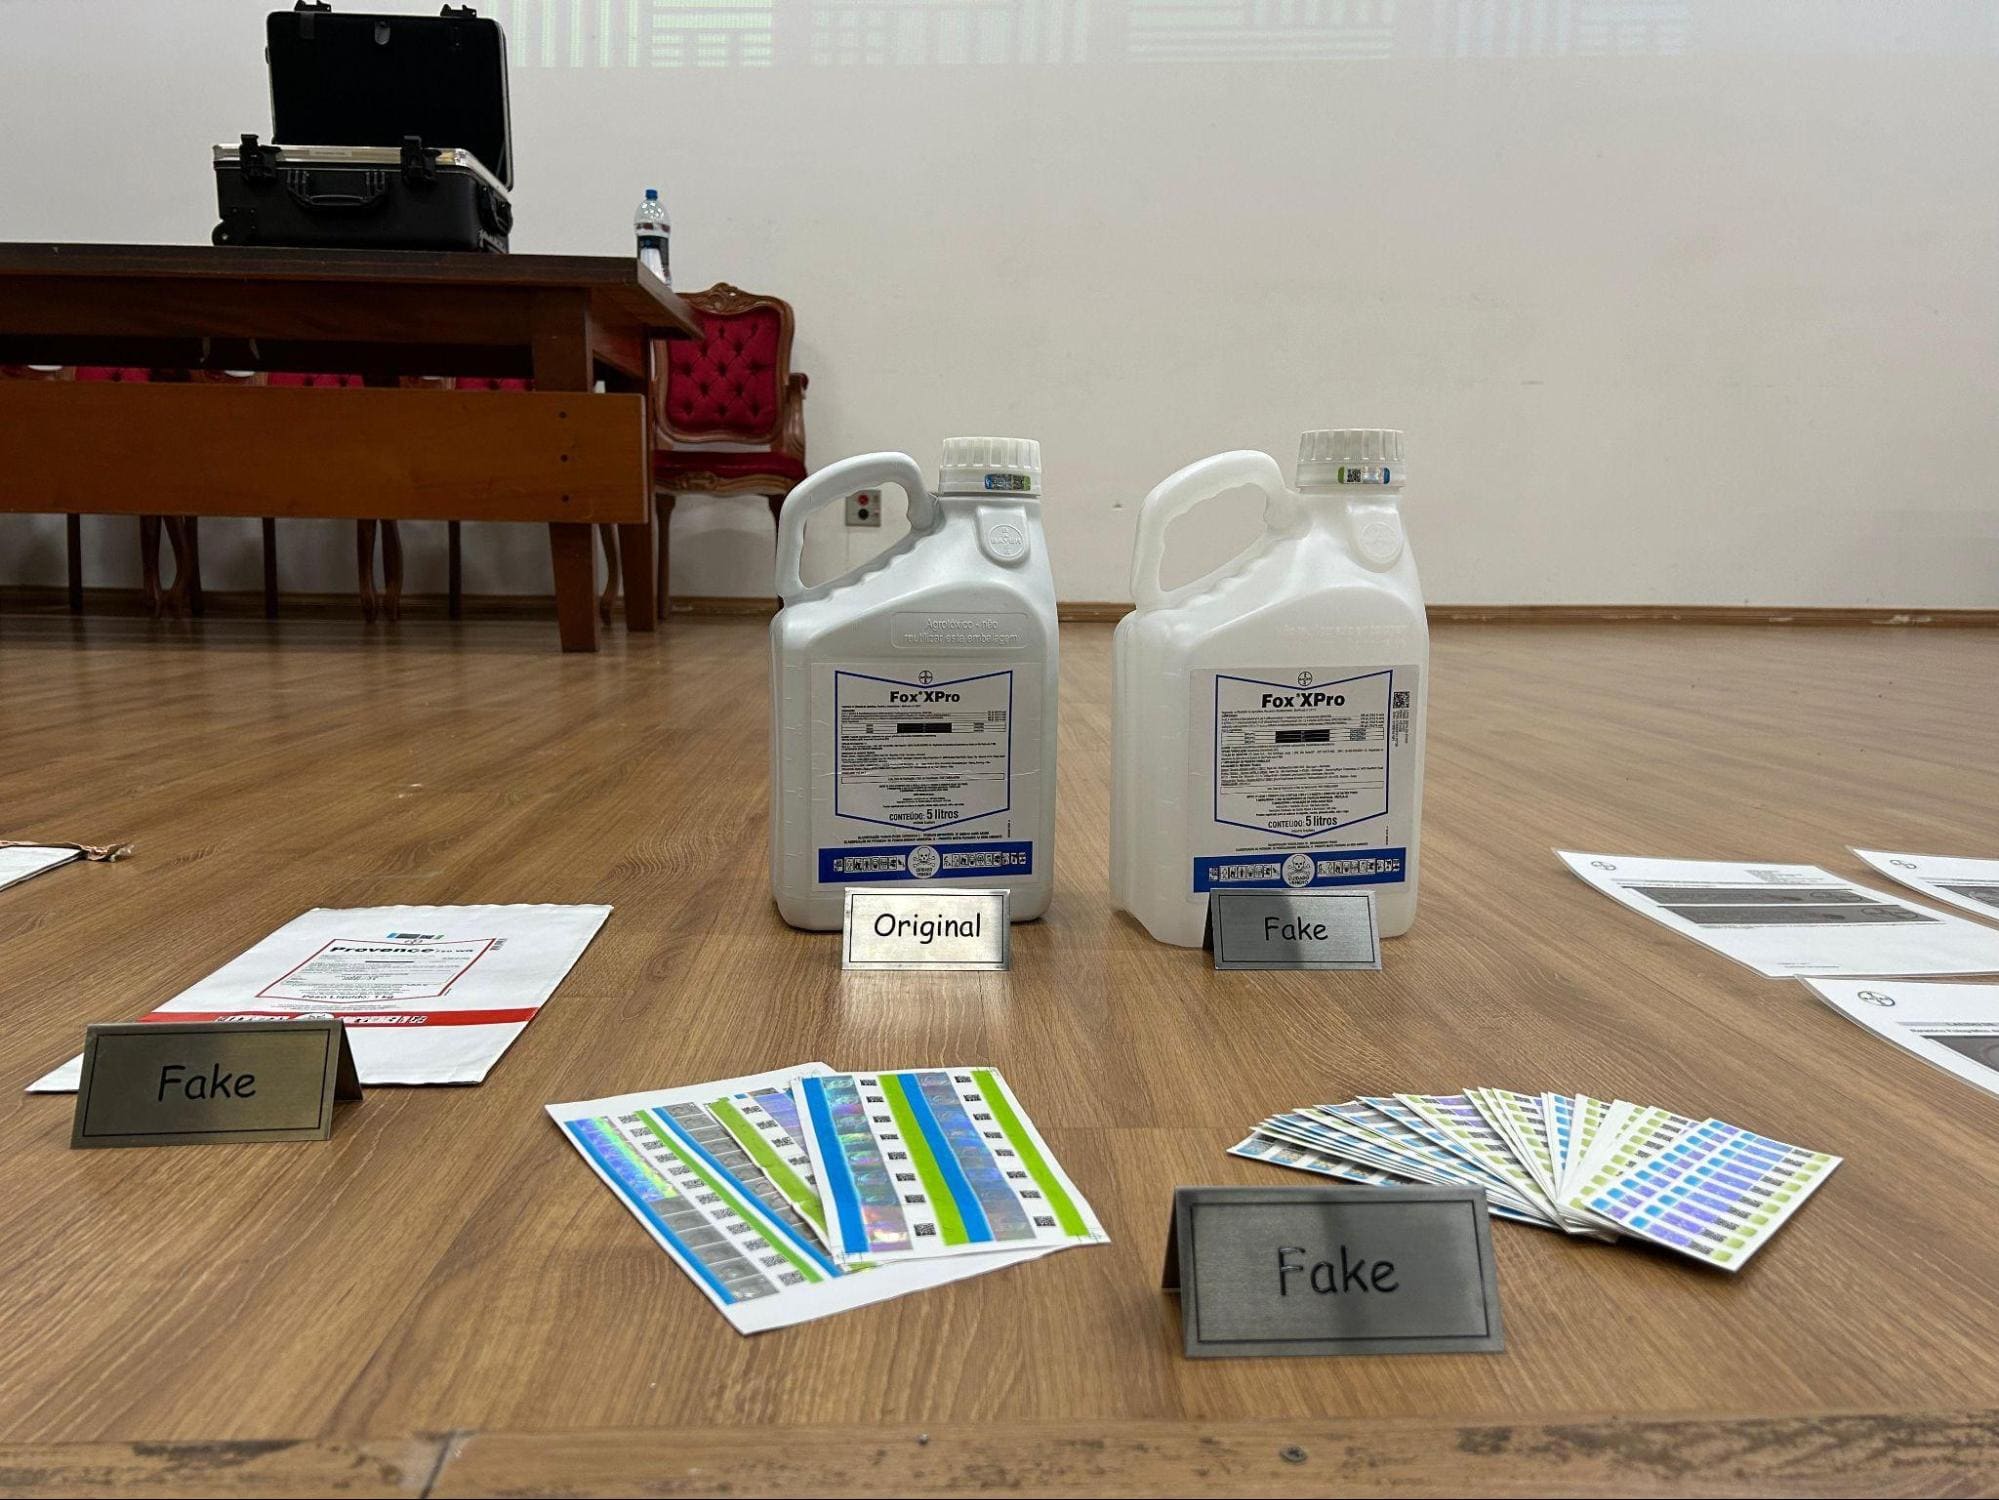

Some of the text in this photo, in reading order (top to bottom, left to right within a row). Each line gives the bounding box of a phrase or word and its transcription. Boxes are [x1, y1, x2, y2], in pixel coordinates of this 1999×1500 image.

[926, 809, 933, 820] 5
[934, 808, 959, 820] litros
[1305, 815, 1312, 827] 5
[1313, 815, 1338, 827] litros
[874, 912, 981, 944] Original
[1264, 916, 1329, 941] Fake
[158, 1063, 256, 1102] Fake
[1277, 1245, 1399, 1296] Fake
